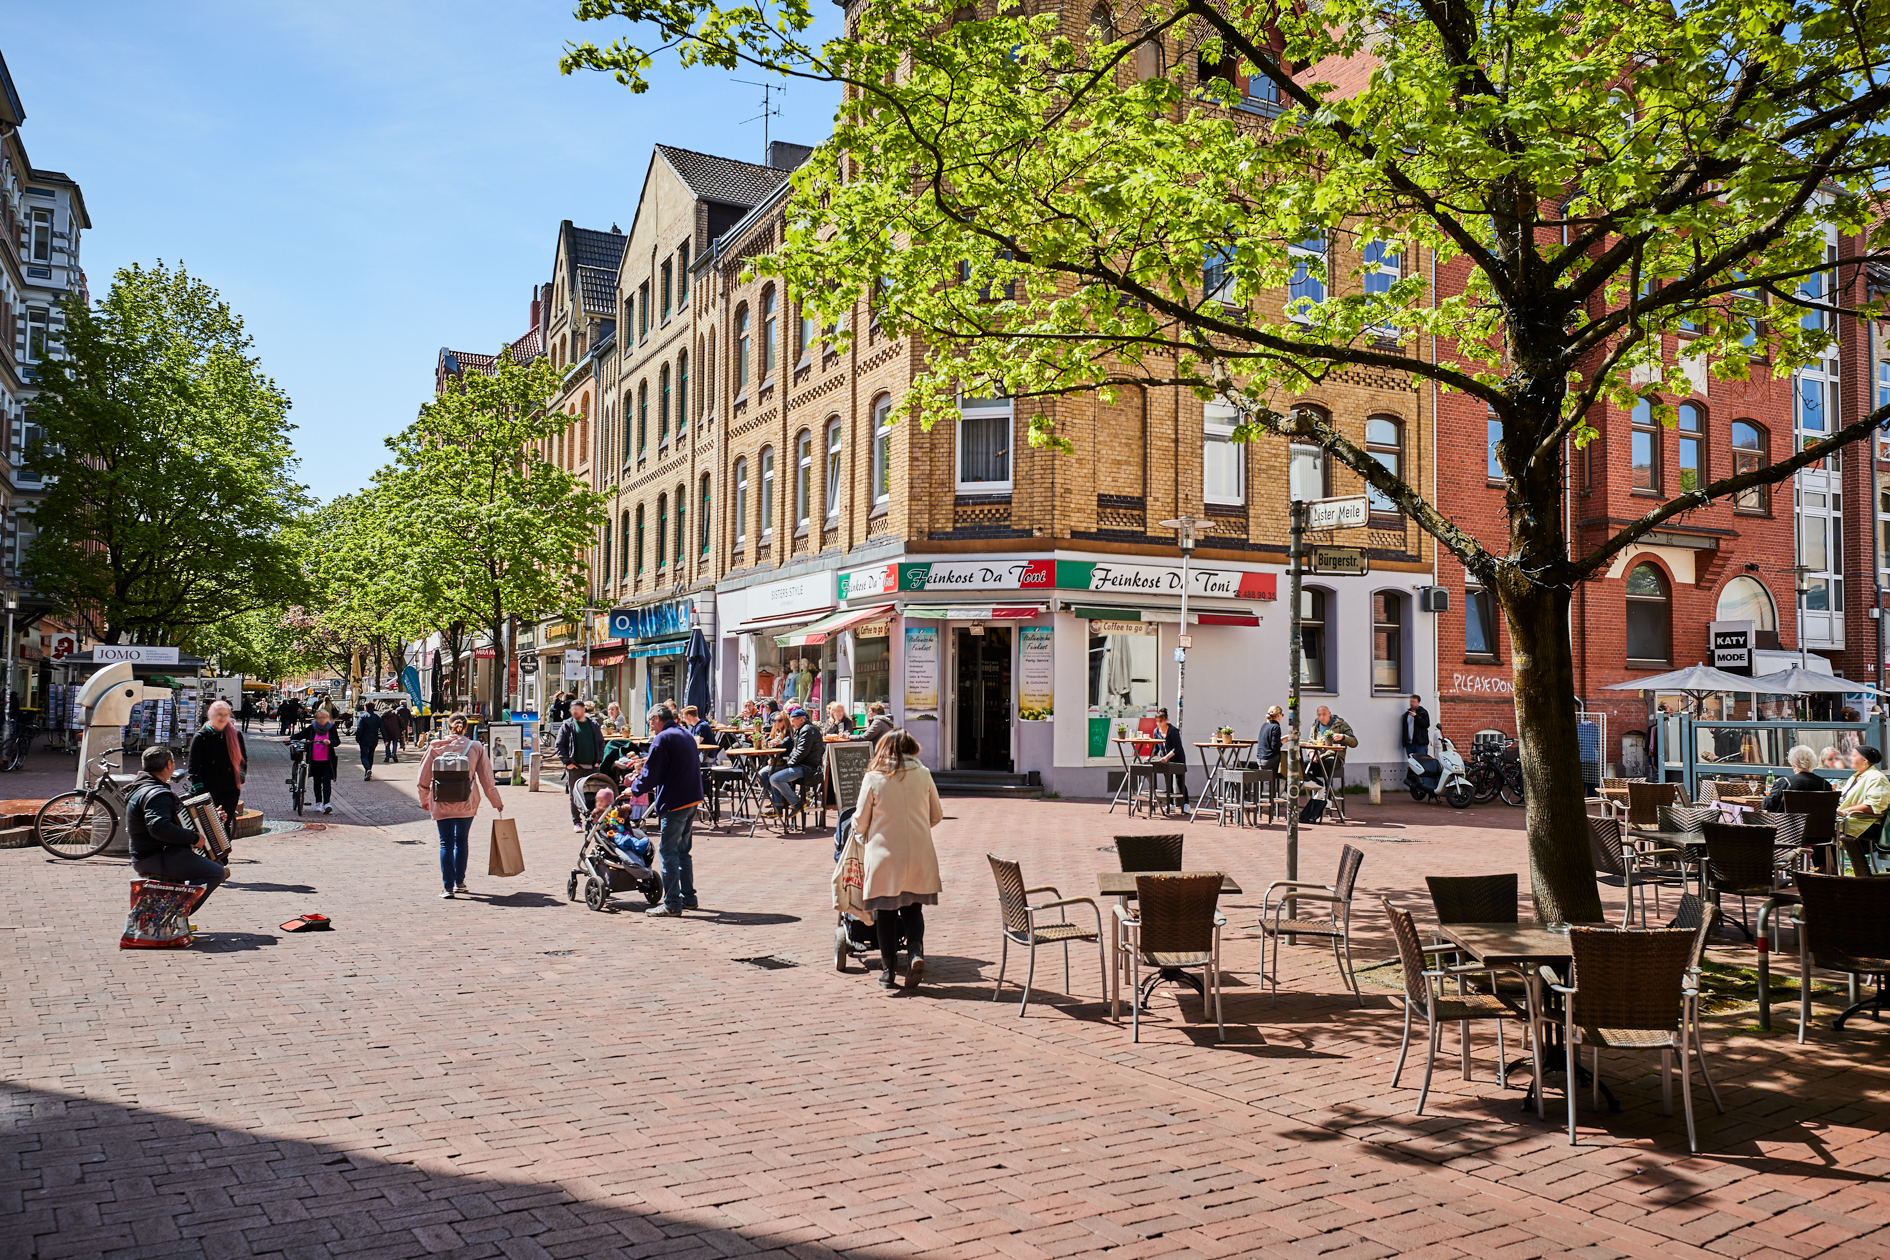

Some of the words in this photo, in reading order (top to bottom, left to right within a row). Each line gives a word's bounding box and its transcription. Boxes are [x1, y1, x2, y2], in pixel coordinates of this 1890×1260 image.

[1314, 508, 1335, 522] Lister
[1338, 504, 1360, 519] Meile
[1318, 553, 1359, 569] Bürgerstr.
[907, 568, 974, 588] Feinkost
[978, 568, 1002, 583] Da
[1008, 565, 1046, 583] Toni
[1091, 568, 1160, 590] Feinkost
[1195, 572, 1230, 592] Toni
[841, 578, 866, 598] Feinkost
[868, 576, 877, 588] Da
[879, 570, 894, 588] Toni
[771, 588, 788, 600] SISTERS
[789, 584, 804, 596] STYLE
[1242, 591, 1256, 599] 488
[1258, 592, 1266, 600] 90
[1267, 592, 1276, 600] 35
[860, 626, 872, 634] Coffee
[878, 627, 883, 635] go
[1103, 622, 1124, 631] Coffee
[1134, 625, 1142, 633] go
[1716, 636, 1746, 646] KATY
[98, 650, 140, 660] JOMO
[1717, 654, 1746, 662] MODE
